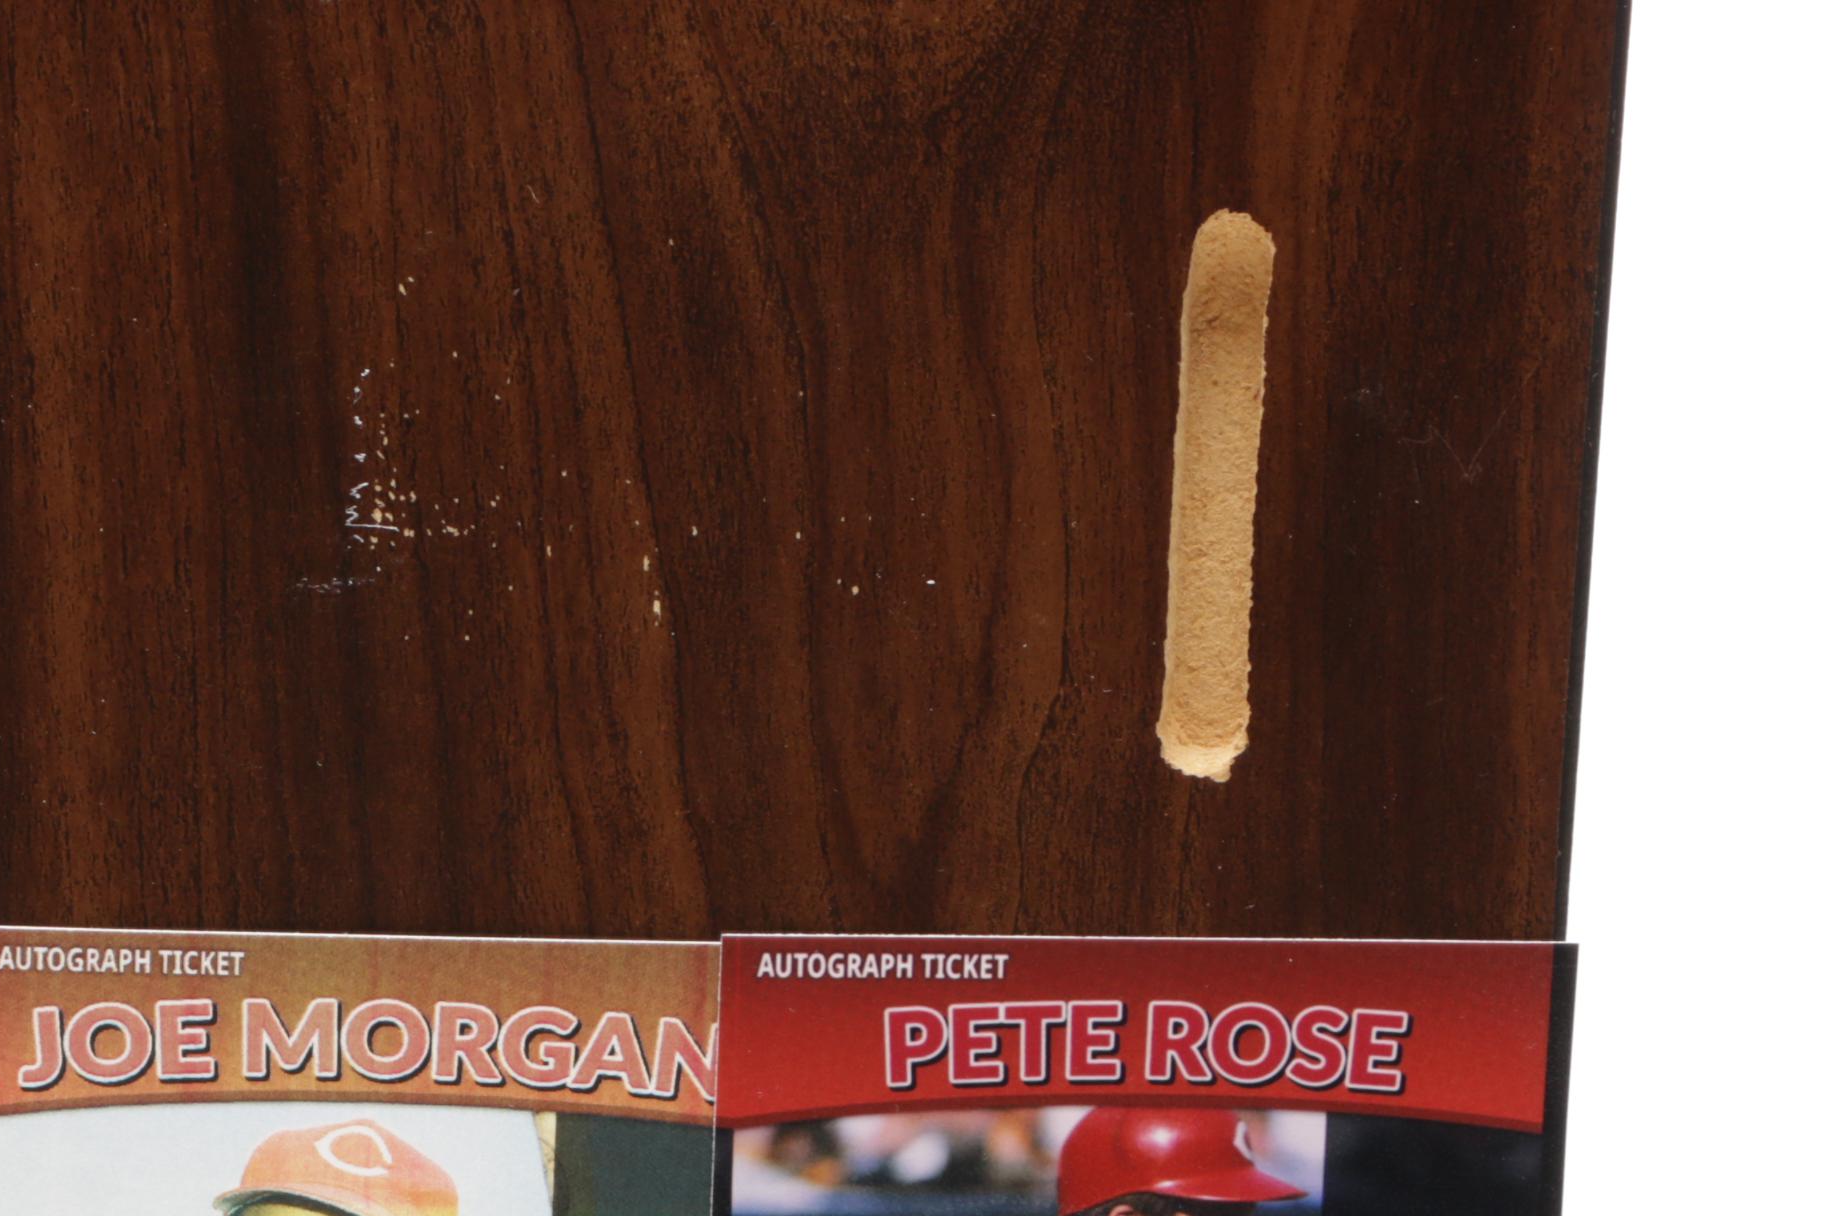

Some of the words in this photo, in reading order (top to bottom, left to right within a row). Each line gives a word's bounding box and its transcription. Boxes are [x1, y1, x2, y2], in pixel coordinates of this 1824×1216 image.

[158, 949, 245, 976] TICKET
[756, 952, 914, 979] AUTOGRAPH
[920, 953, 1009, 980] TICKET
[18, 998, 217, 1090] JOE
[241, 997, 718, 1102] MORGAN
[884, 1001, 1127, 1090] PETE
[1145, 1001, 1411, 1093] ROSE
[313, 1124, 393, 1176] C
